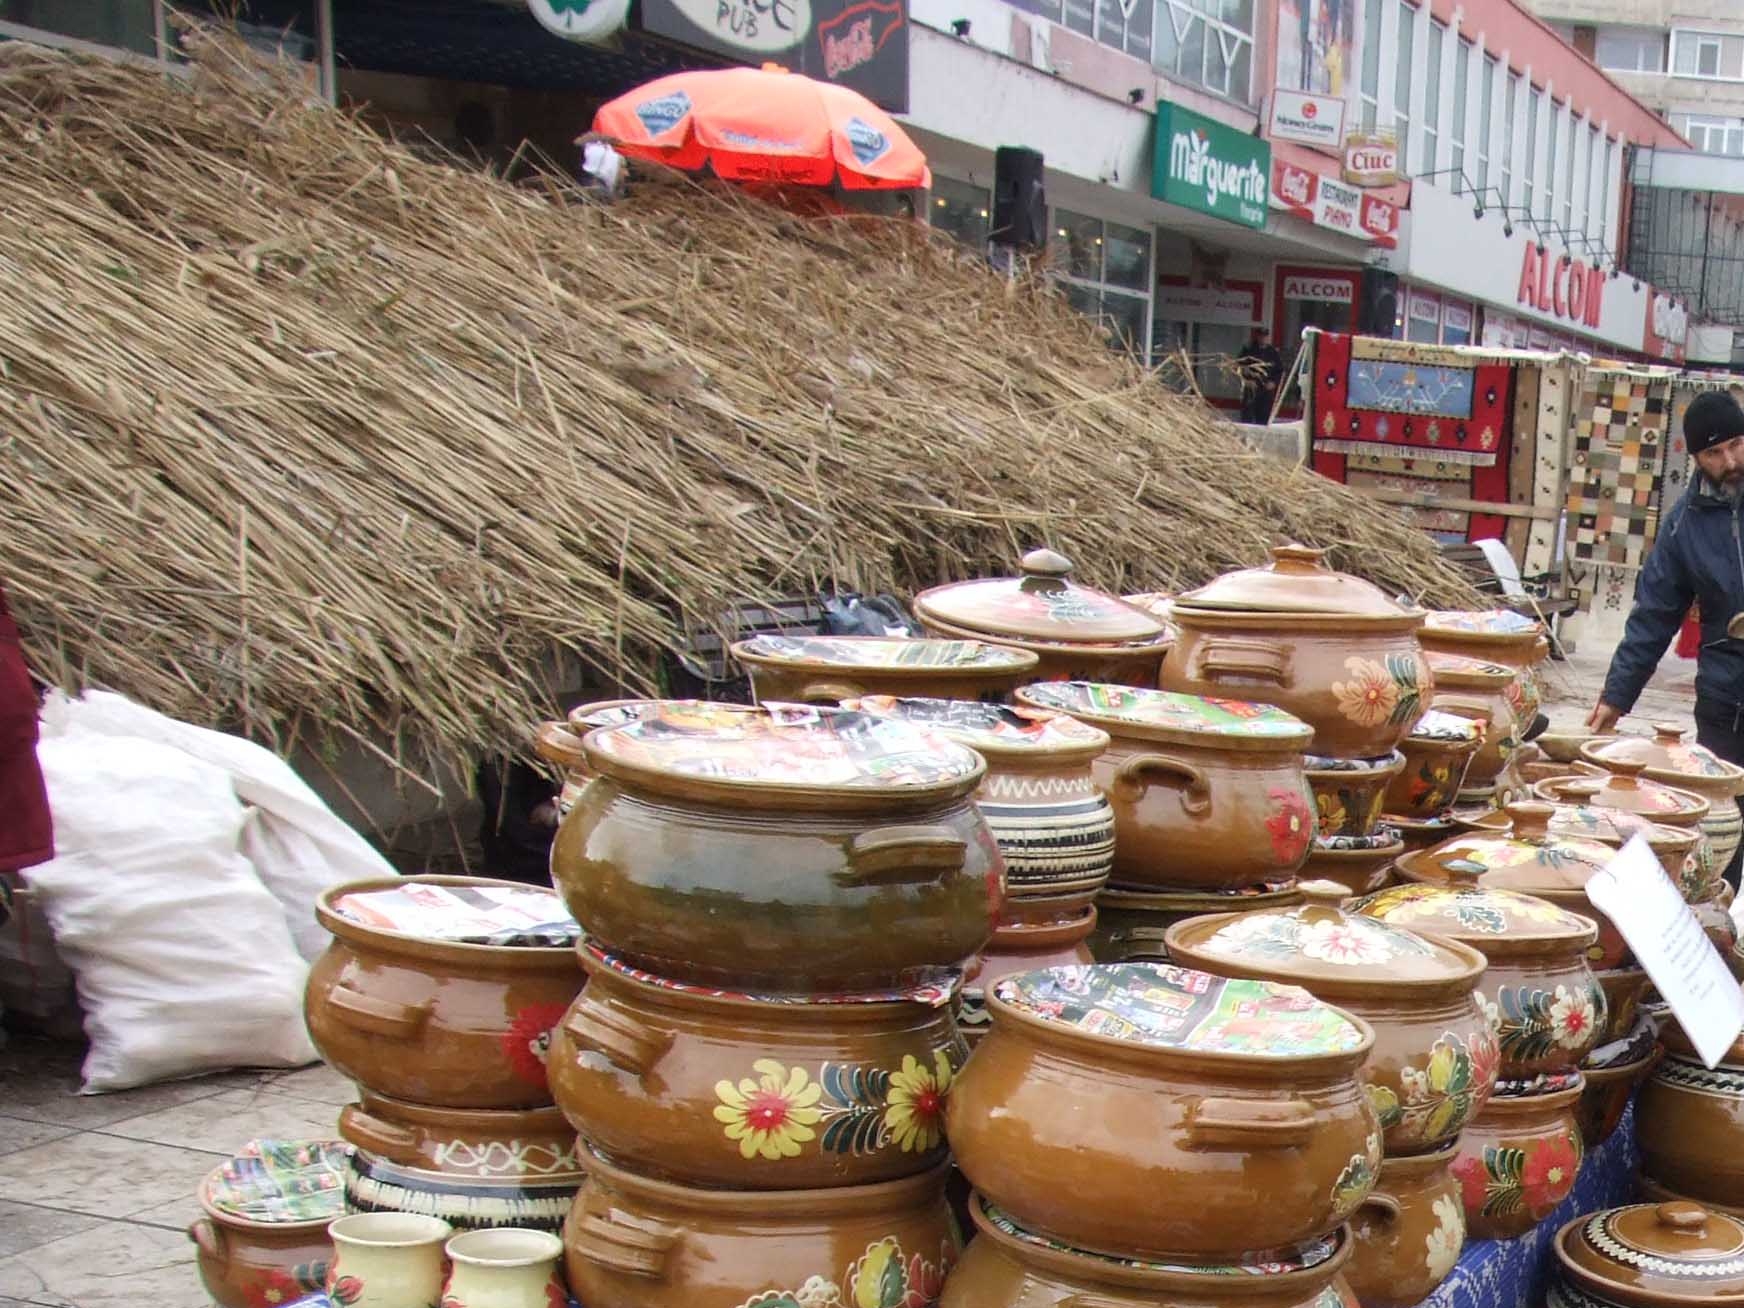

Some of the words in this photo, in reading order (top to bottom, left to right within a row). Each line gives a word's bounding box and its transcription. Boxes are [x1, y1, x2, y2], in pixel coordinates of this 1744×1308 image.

[716, 0, 758, 37] PUB
[1352, 152, 1393, 171] Ciuc
[1323, 205, 1354, 229] PIANO
[1287, 281, 1351, 298] ALCOM
[1518, 239, 1605, 329] ALCOM
